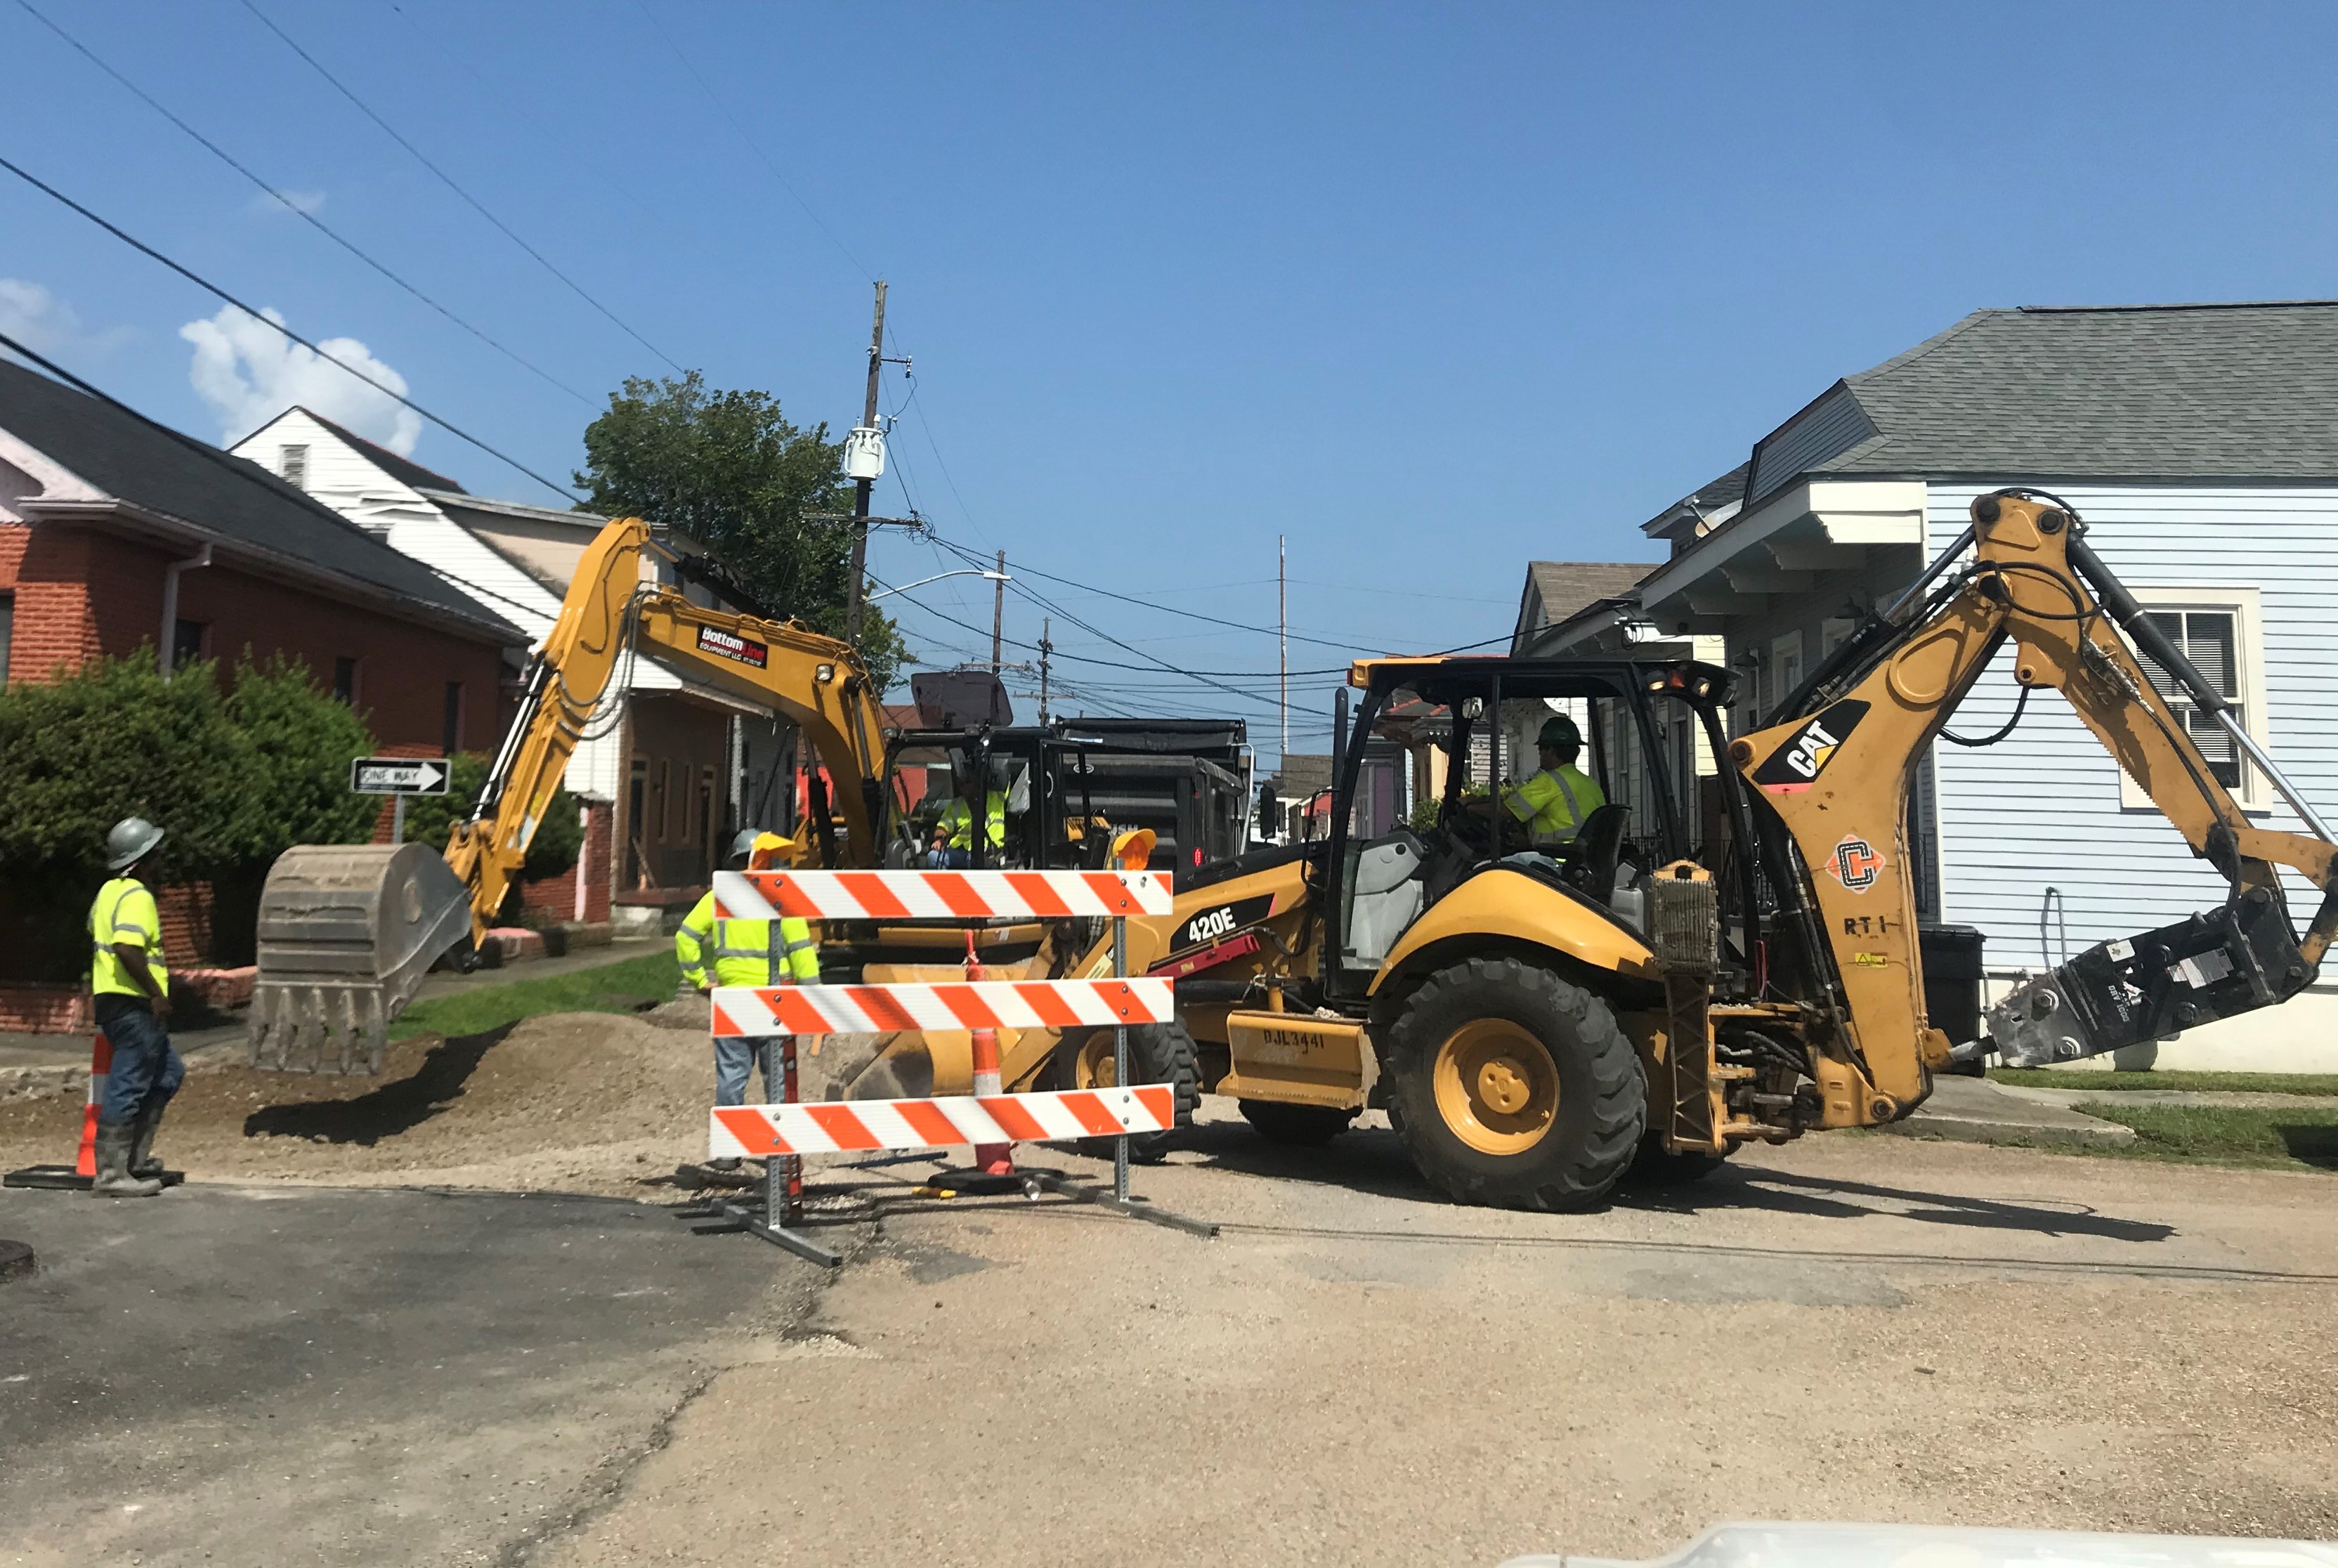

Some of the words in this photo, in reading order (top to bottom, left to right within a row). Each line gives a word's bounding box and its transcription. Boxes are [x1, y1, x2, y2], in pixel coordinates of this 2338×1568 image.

[699, 642, 731, 657] EQUIPMENT
[1787, 720, 1839, 778] CAT
[1189, 906, 1236, 943] 420E
